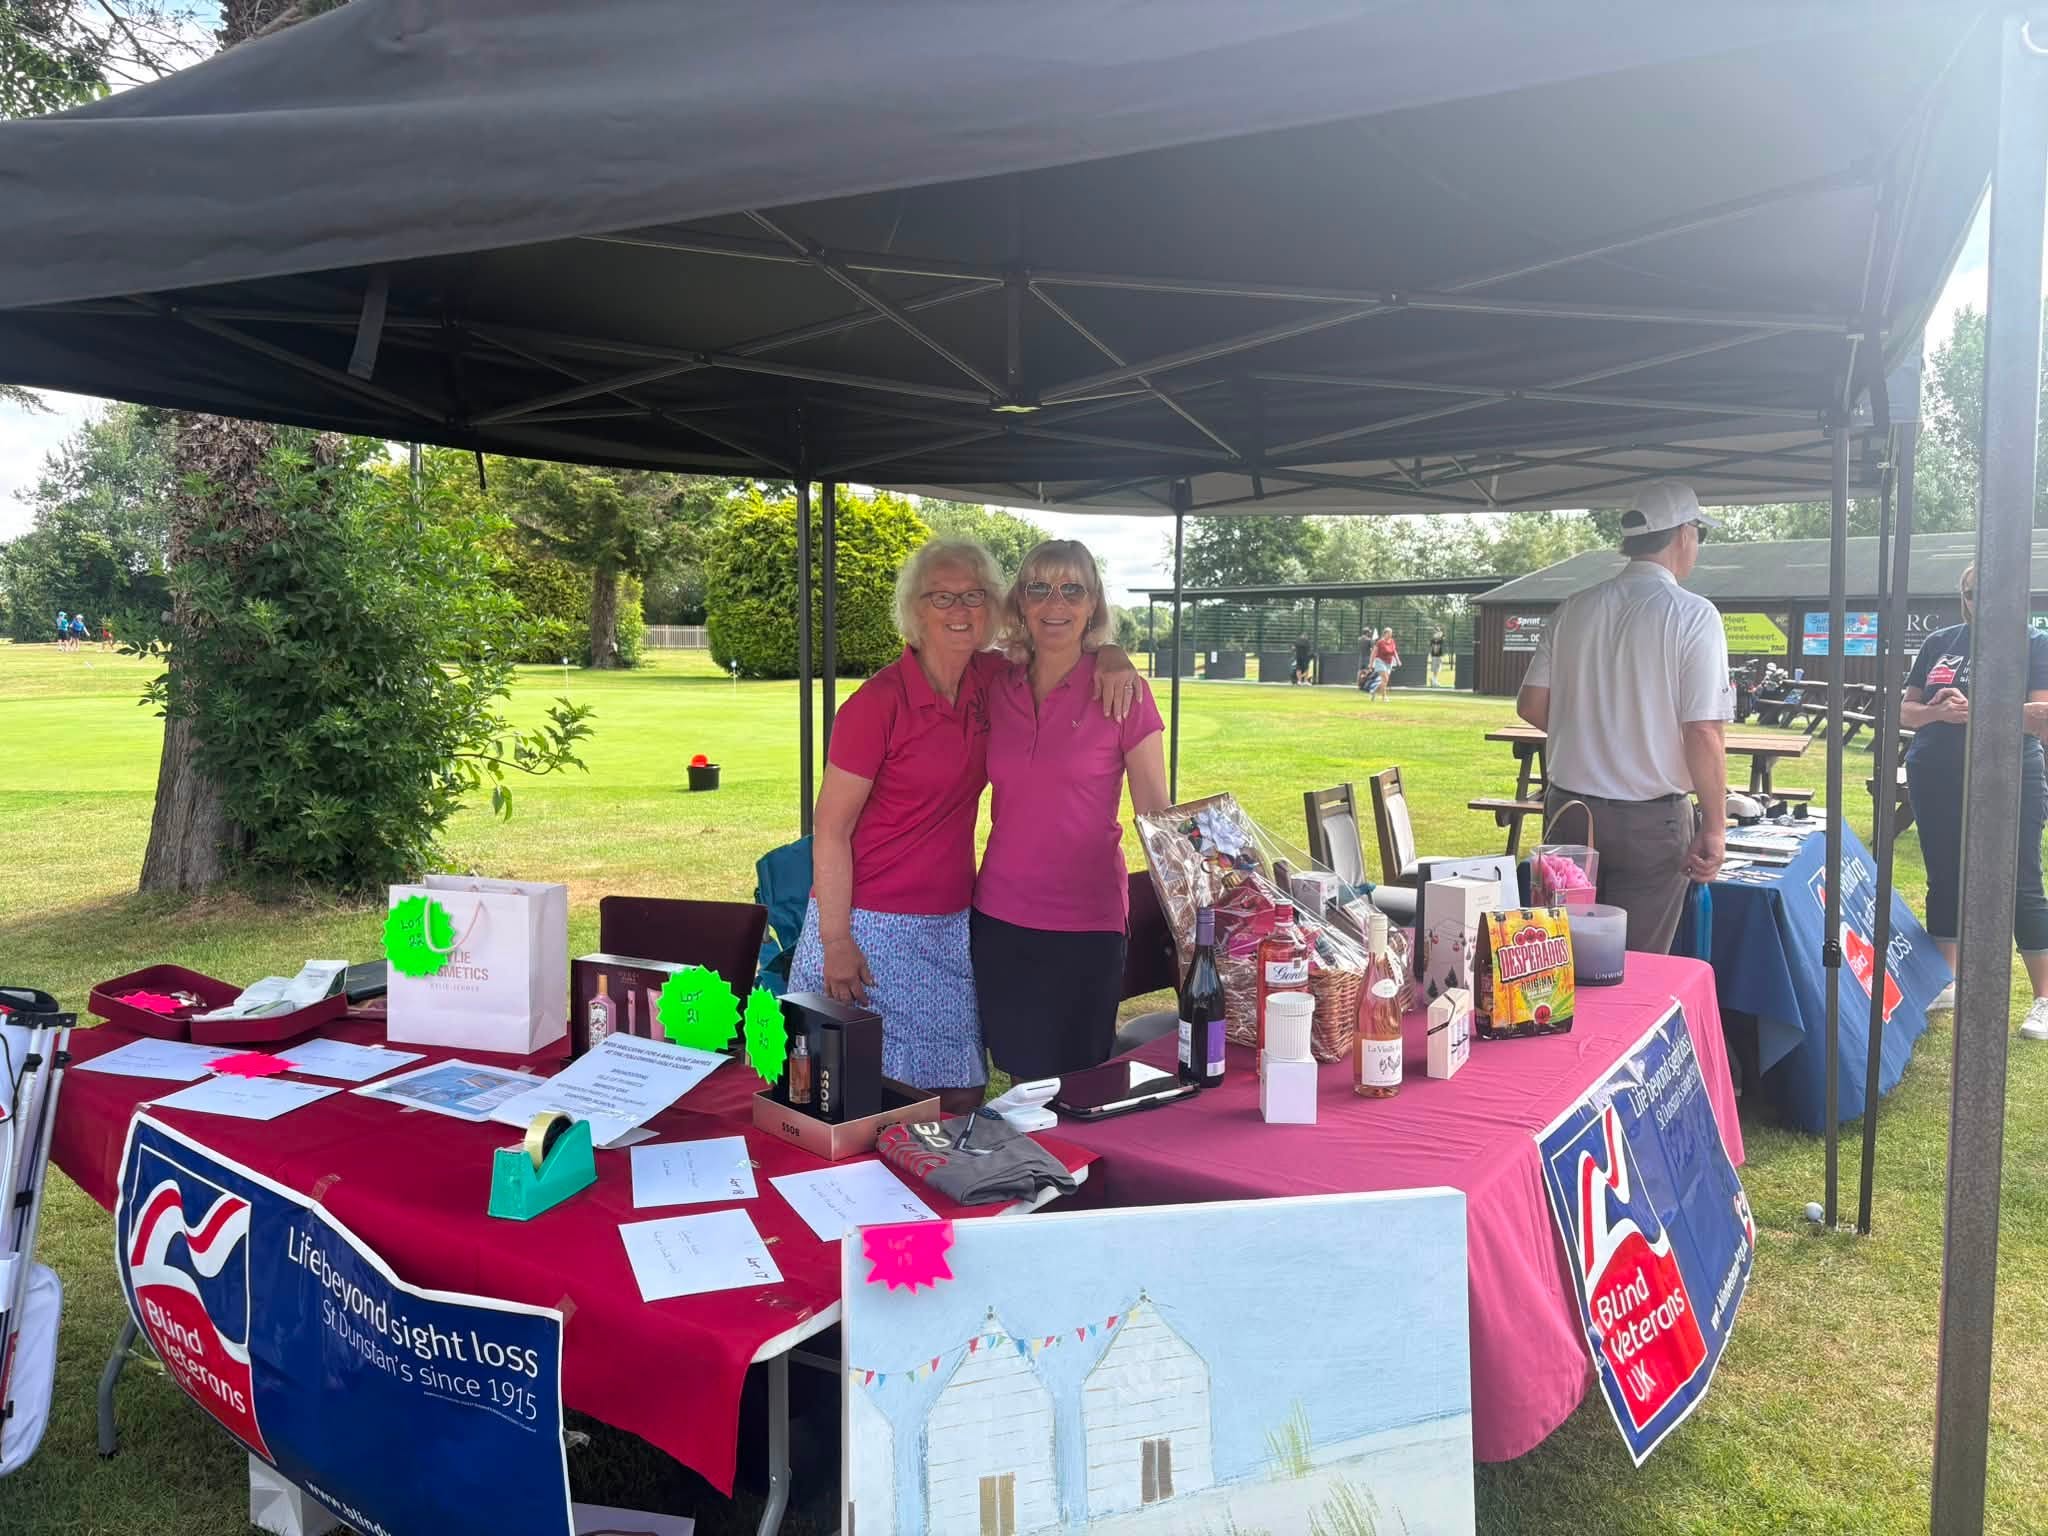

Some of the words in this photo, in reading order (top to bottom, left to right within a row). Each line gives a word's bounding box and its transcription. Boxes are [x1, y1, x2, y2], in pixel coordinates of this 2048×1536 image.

[447, 951, 471, 964] YLIE
[1500, 939, 1569, 978] DESPERADOS
[820, 1069, 830, 1113] BOSS
[1627, 1085, 1649, 1119] Life
[1640, 1053, 1673, 1104] beyond
[145, 1296, 202, 1357] Blind
[288, 1226, 323, 1277] Life
[321, 1251, 388, 1336] beyond
[391, 1316, 467, 1363] sight
[471, 1330, 538, 1379] loss
[1597, 1266, 1650, 1330] Blind
[1610, 1287, 1685, 1365] Veterans
[157, 1335, 247, 1415] Veterans
[321, 1299, 337, 1328] St
[338, 1316, 413, 1384] Dunstan's
[420, 1363, 480, 1399] since
[489, 1377, 537, 1421] 1915
[1625, 1359, 1656, 1403] UK
